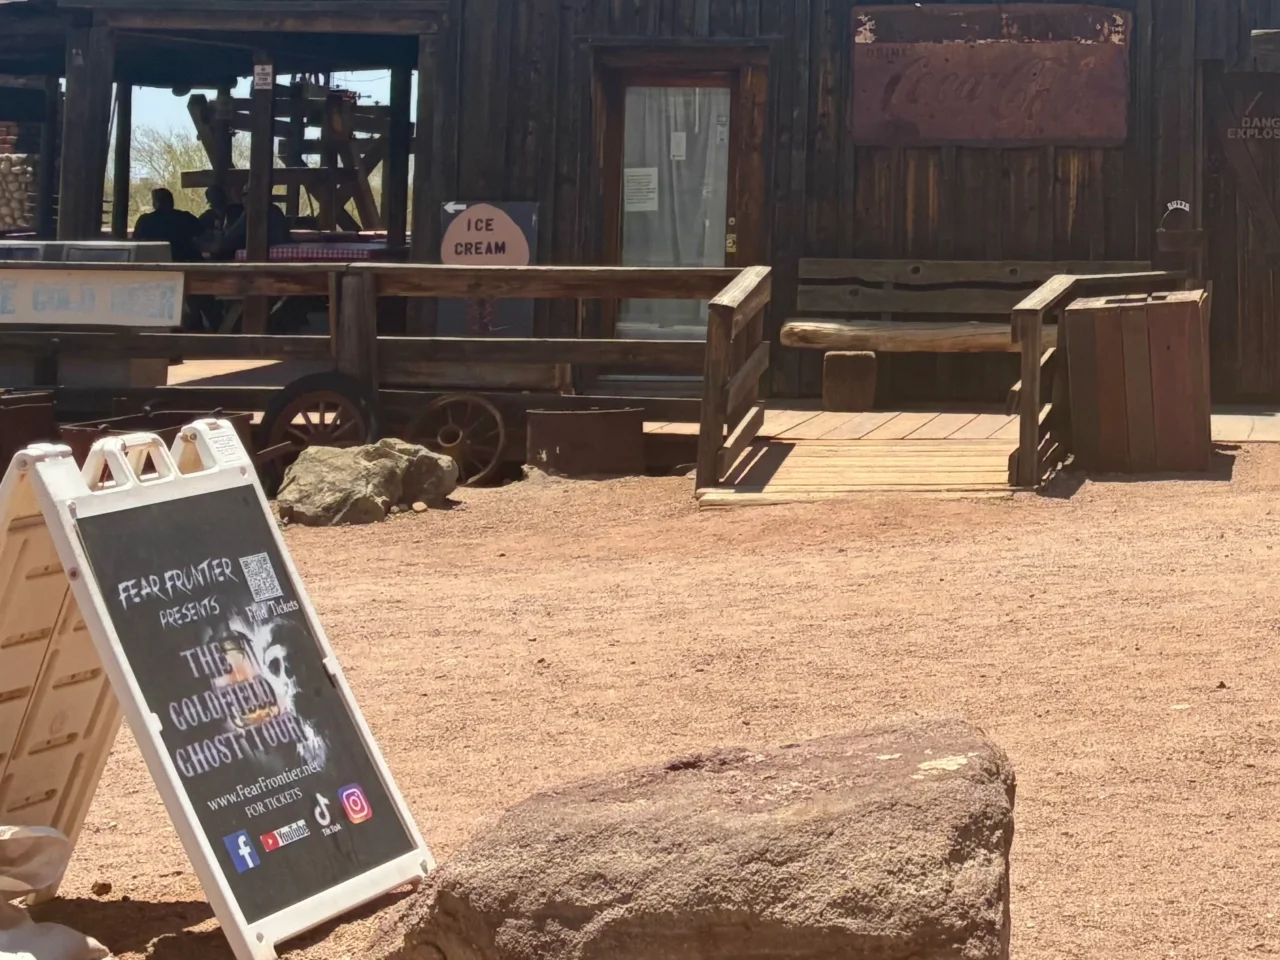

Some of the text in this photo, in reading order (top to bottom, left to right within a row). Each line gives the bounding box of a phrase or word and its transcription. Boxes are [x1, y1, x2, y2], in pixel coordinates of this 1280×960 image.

[466, 218, 495, 233] ICE
[454, 241, 507, 256] CREAM
[118, 557, 240, 611] FEAR FRONTIER
[159, 595, 220, 630] PRESENTS
[245, 599, 299, 622] Find Tickets
[179, 641, 232, 678] THE
[169, 676, 277, 731] GOLDFIELD
[175, 731, 244, 778] GHOST
[207, 760, 321, 811] www.FearFrontier.net
[245, 787, 303, 818] FOR TICKETS
[277, 821, 311, 845] YouTube
[321, 822, 343, 837] TikTok
